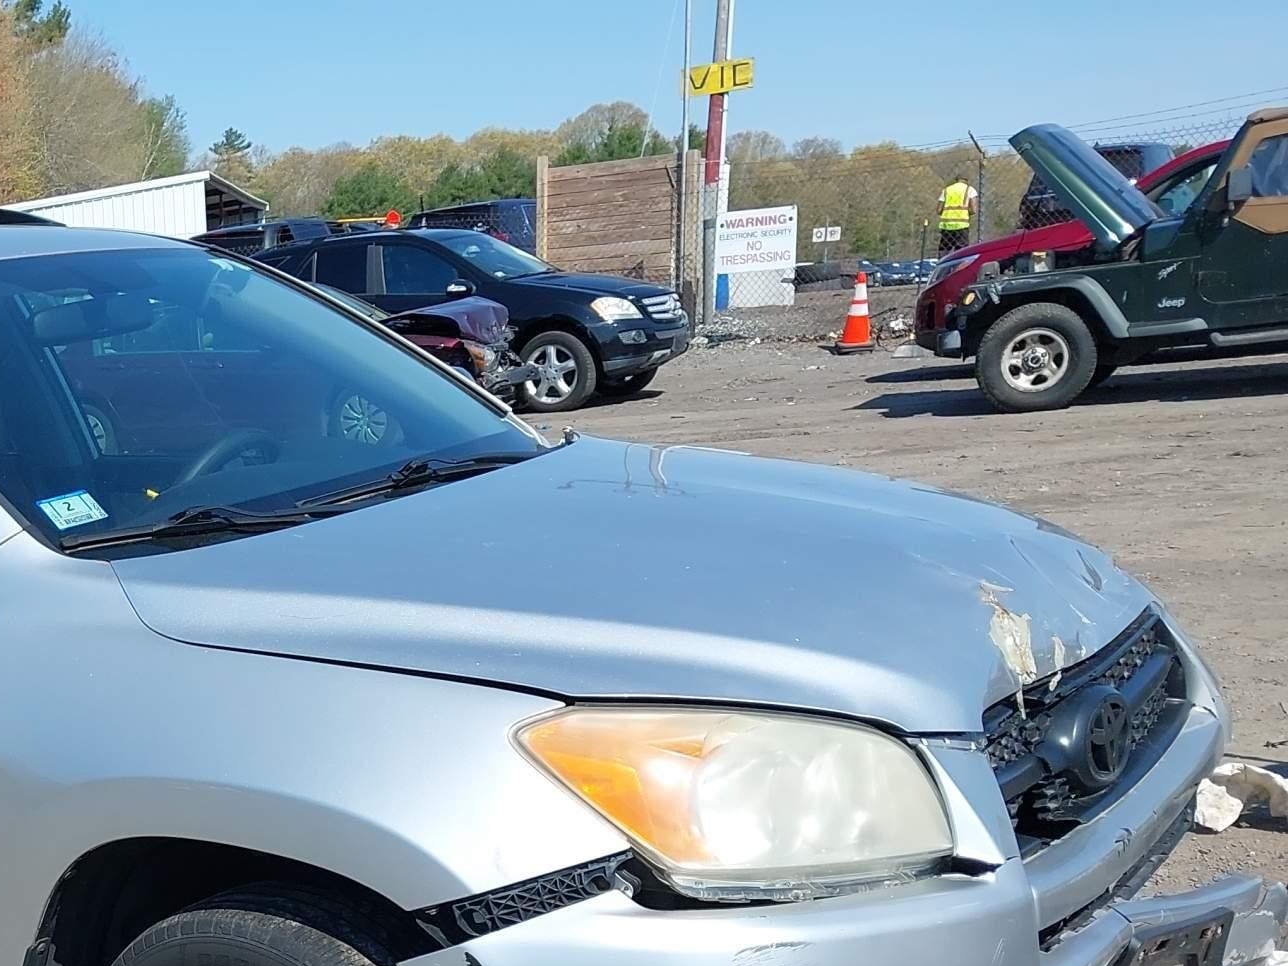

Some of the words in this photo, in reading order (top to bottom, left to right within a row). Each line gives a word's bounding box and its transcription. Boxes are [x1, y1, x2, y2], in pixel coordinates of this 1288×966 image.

[725, 214, 787, 229] WARNING
[719, 231, 758, 241] ELECTRONIC
[760, 228, 792, 238] SECURITY
[746, 240, 762, 251] NO
[720, 250, 791, 266] TRESPASSING
[1157, 296, 1185, 308] Jeep
[62, 501, 75, 512] 2
